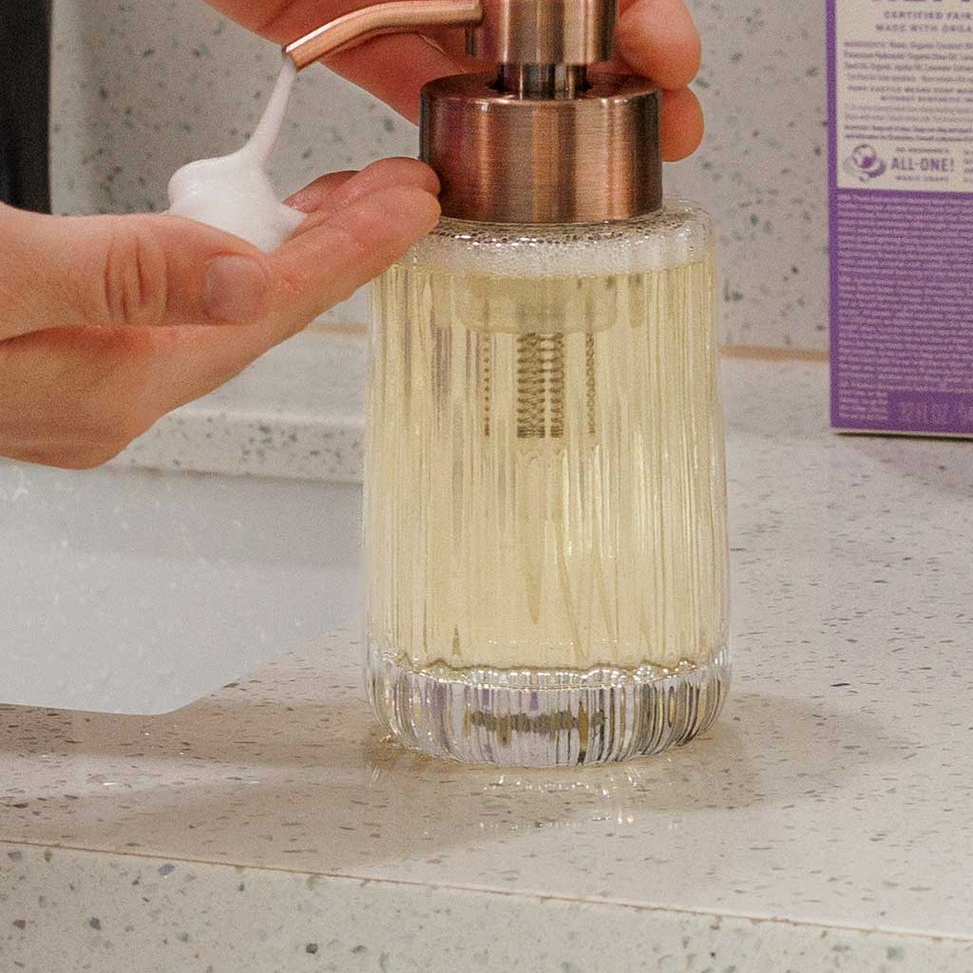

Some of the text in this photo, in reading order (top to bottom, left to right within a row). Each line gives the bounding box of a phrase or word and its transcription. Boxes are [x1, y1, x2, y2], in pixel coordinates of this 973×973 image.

[884, 11, 943, 20] CERTIFIED
[947, 11, 972, 20] FAIR
[910, 24, 937, 32] WITH
[891, 157, 954, 172] ALL-ONE!
